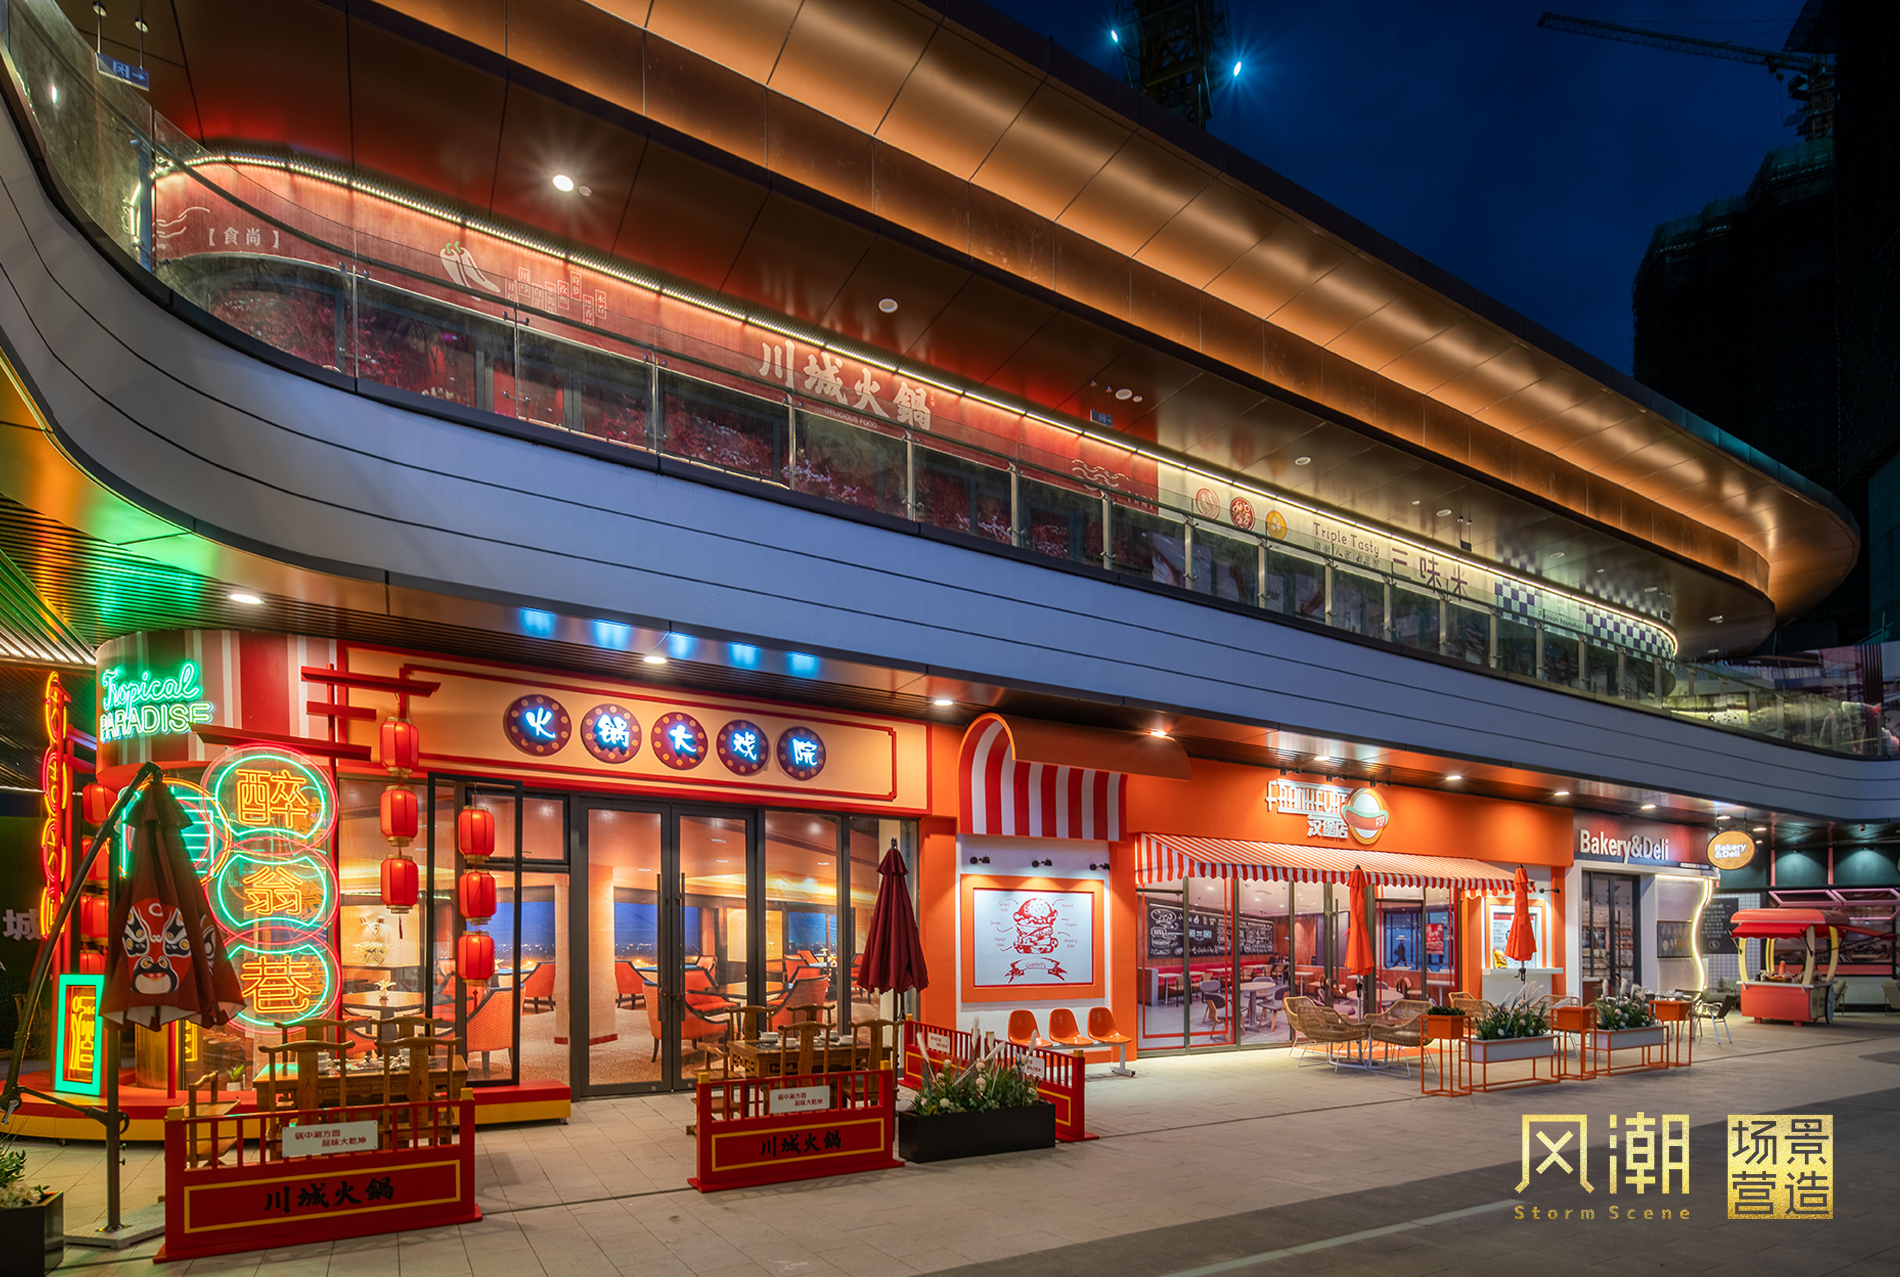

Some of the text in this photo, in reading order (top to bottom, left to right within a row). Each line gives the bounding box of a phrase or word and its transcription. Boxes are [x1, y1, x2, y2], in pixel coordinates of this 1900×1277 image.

[824, 407, 878, 430] DELICIOUS FOOD
[1313, 522, 1380, 558] Triple Tasty
[102, 663, 200, 719] Tropical
[100, 703, 212, 742] PARADISE
[1307, 814, 1349, 839] 汉堡店
[1579, 829, 1669, 864] Bakery&Deli
[1714, 843, 1747, 853] Bakery
[1714, 850, 1741, 859] &Deli
[236, 769, 312, 1014] 醉翁巷
